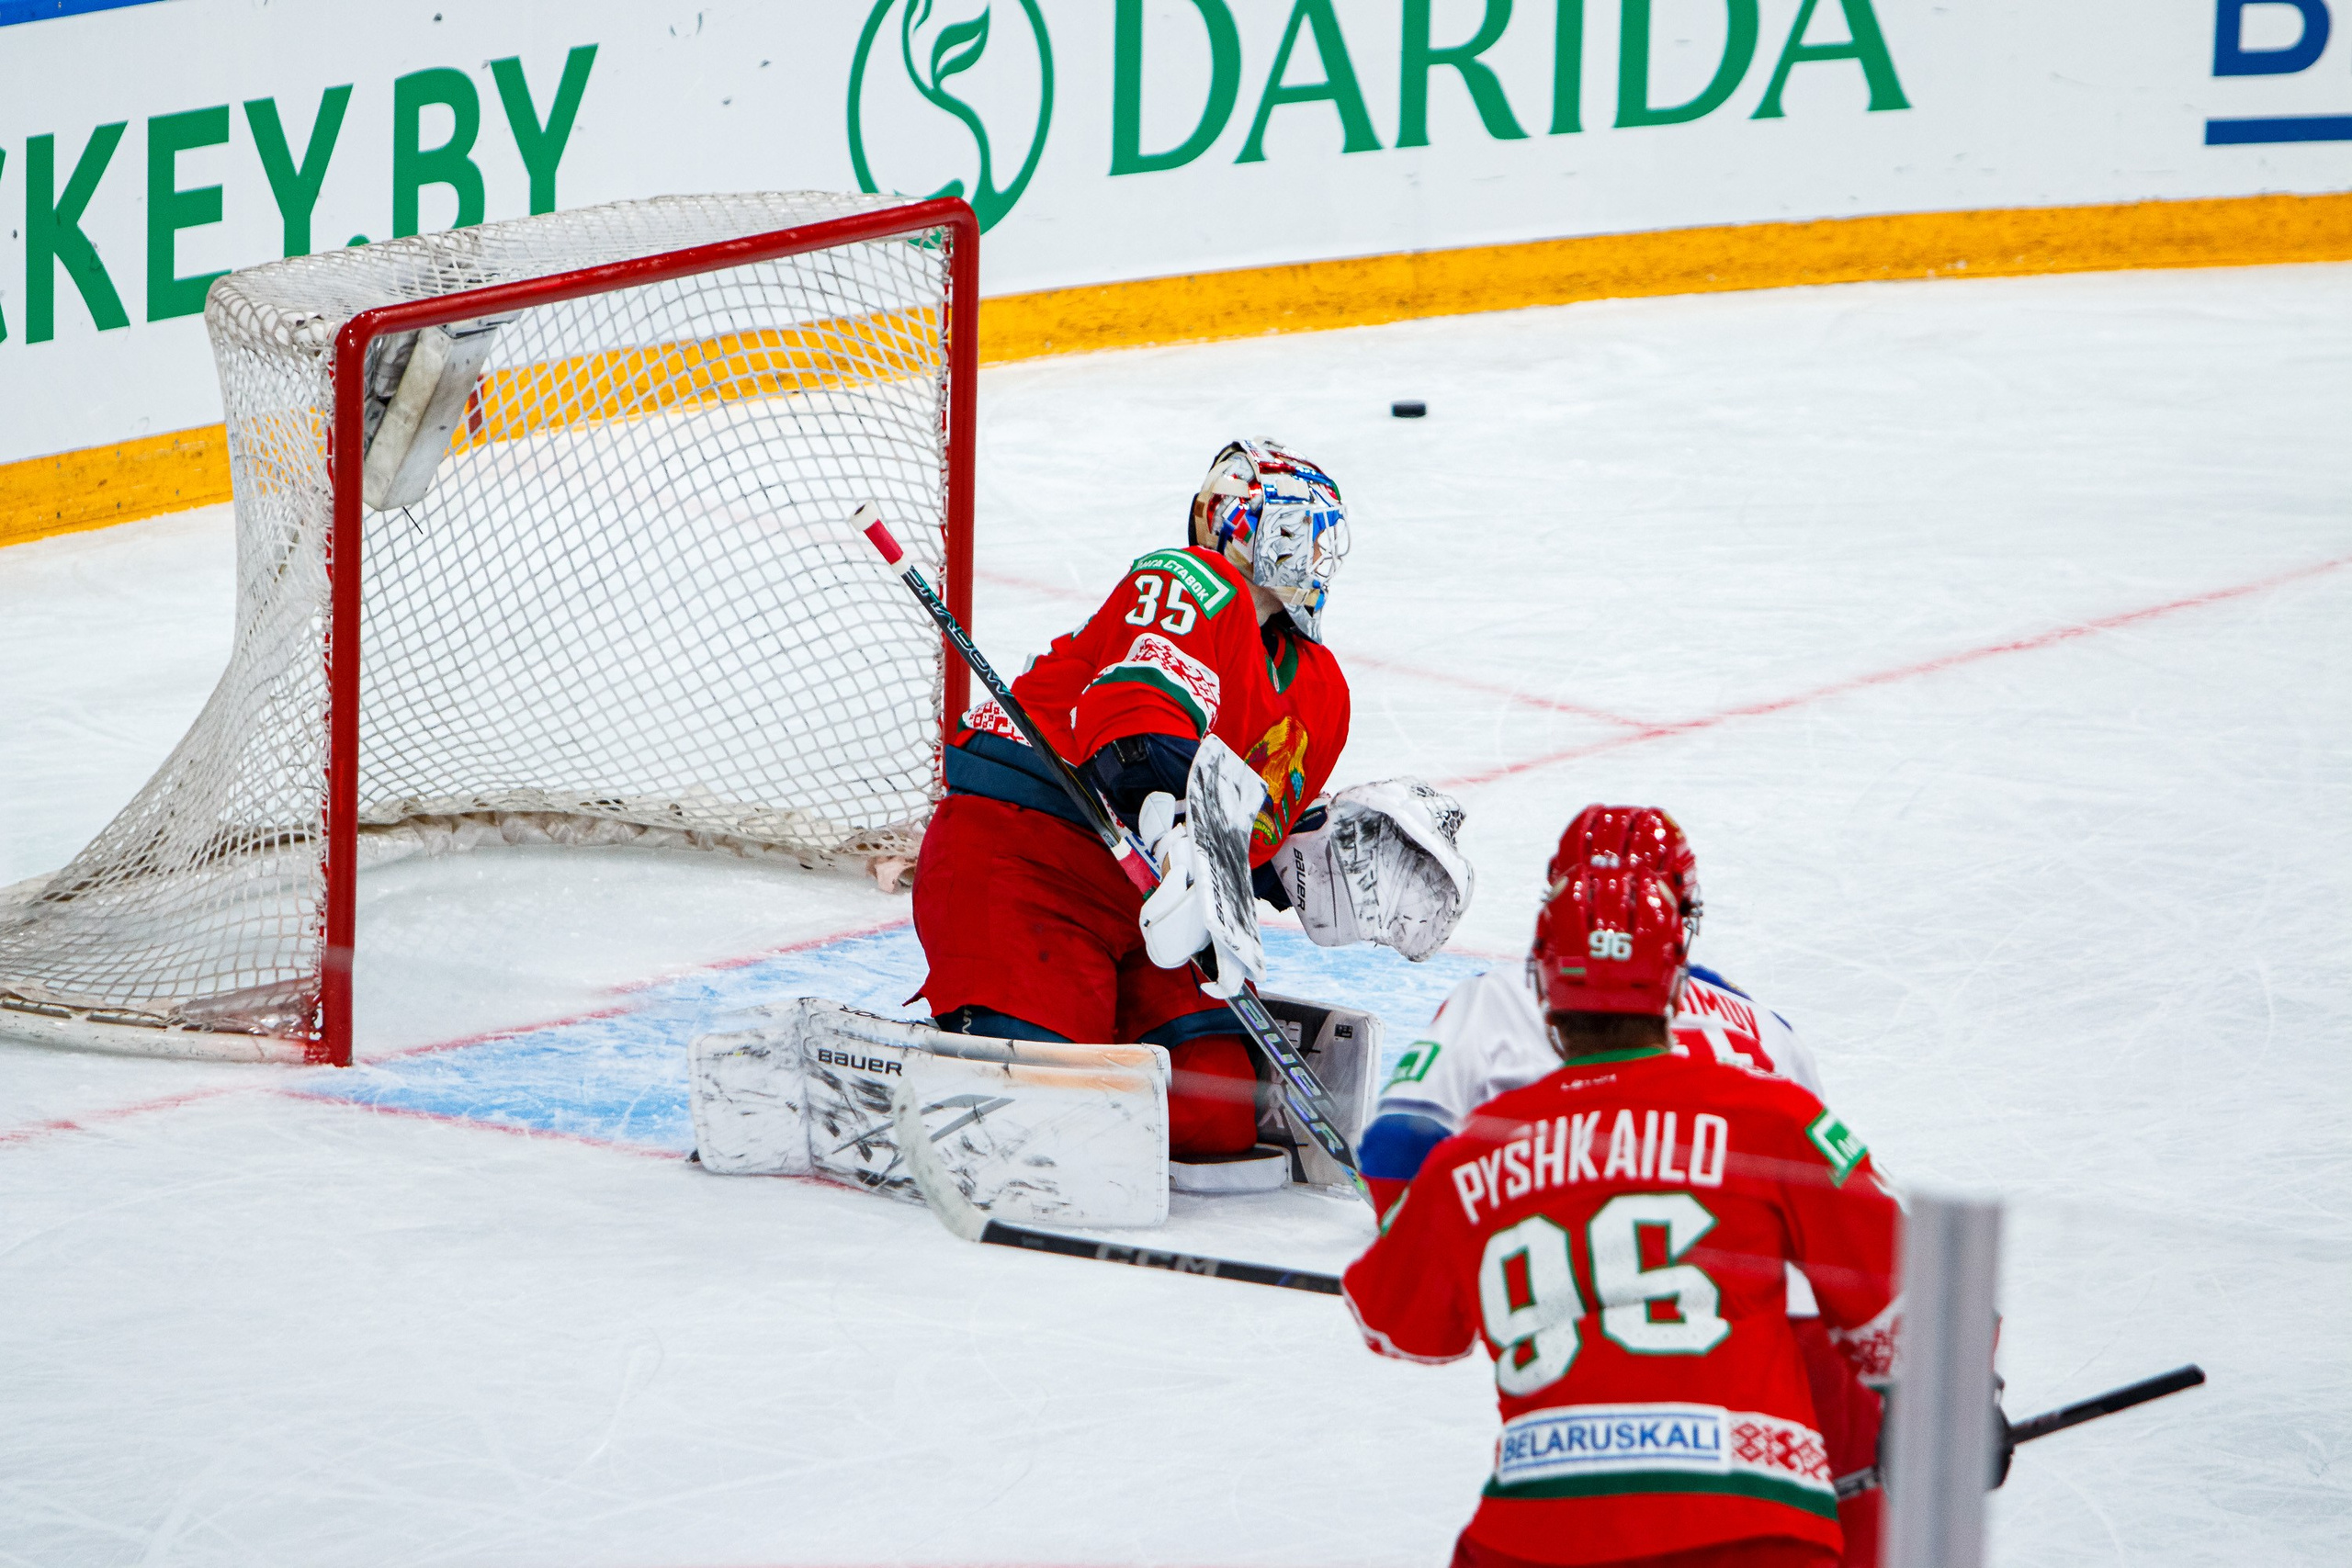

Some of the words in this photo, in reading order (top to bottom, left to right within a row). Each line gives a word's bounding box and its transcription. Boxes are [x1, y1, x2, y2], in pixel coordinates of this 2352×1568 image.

[1108, 0, 1913, 176] DARIDA
[0, 42, 600, 344] KEY.BY
[1125, 574, 1197, 636] 35
[1163, 558, 1210, 603] СТАВОК
[1293, 846, 1306, 912] BAUER
[1588, 929, 1634, 962] 96
[818, 1047, 903, 1077] BAUER
[1238, 987, 1345, 1155] AUER
[1452, 1108, 1728, 1225] PYSHKAILO
[1095, 1241, 1220, 1278] CCM
[1479, 1191, 1731, 1398] 96
[1503, 1421, 1721, 1463] BELARUSKALI
